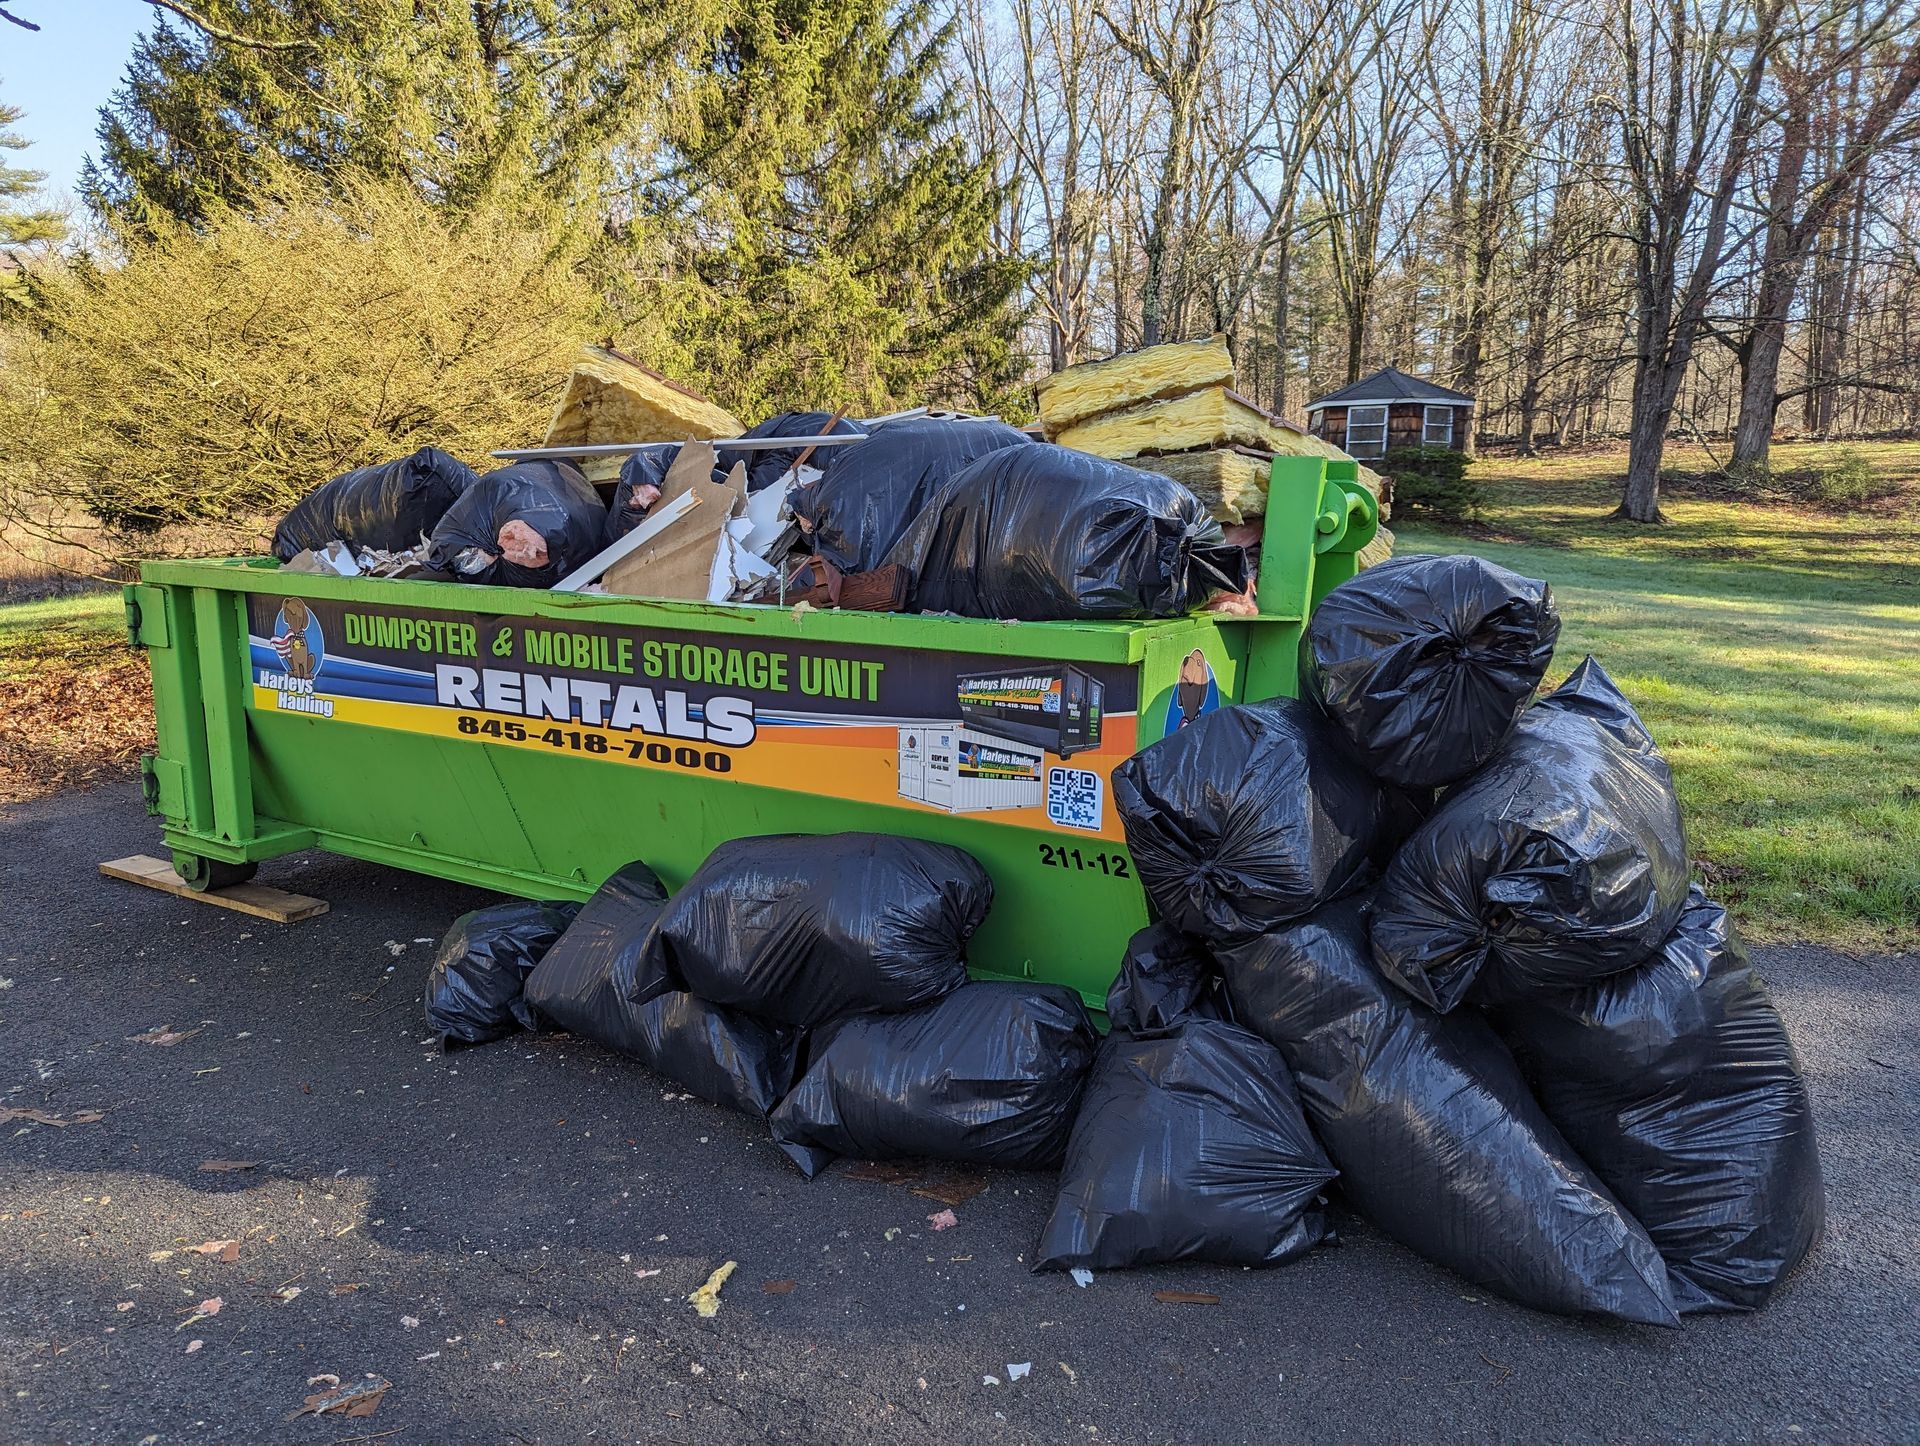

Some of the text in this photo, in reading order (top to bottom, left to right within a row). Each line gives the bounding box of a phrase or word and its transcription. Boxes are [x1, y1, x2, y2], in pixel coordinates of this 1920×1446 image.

[344, 613, 885, 702] DUMPSTER & MOBILE STORAGE UNIT
[259, 670, 314, 695] Harleys
[968, 676, 1053, 691] Harleys Hauling
[278, 691, 334, 718] Hauling
[435, 663, 755, 746] RENTALS
[457, 715, 732, 773] 845-418-7000
[981, 748, 1035, 767] Harleys Hauling
[1056, 820, 1100, 831] Harleys Hauling
[1038, 843, 1131, 880] 211-12
